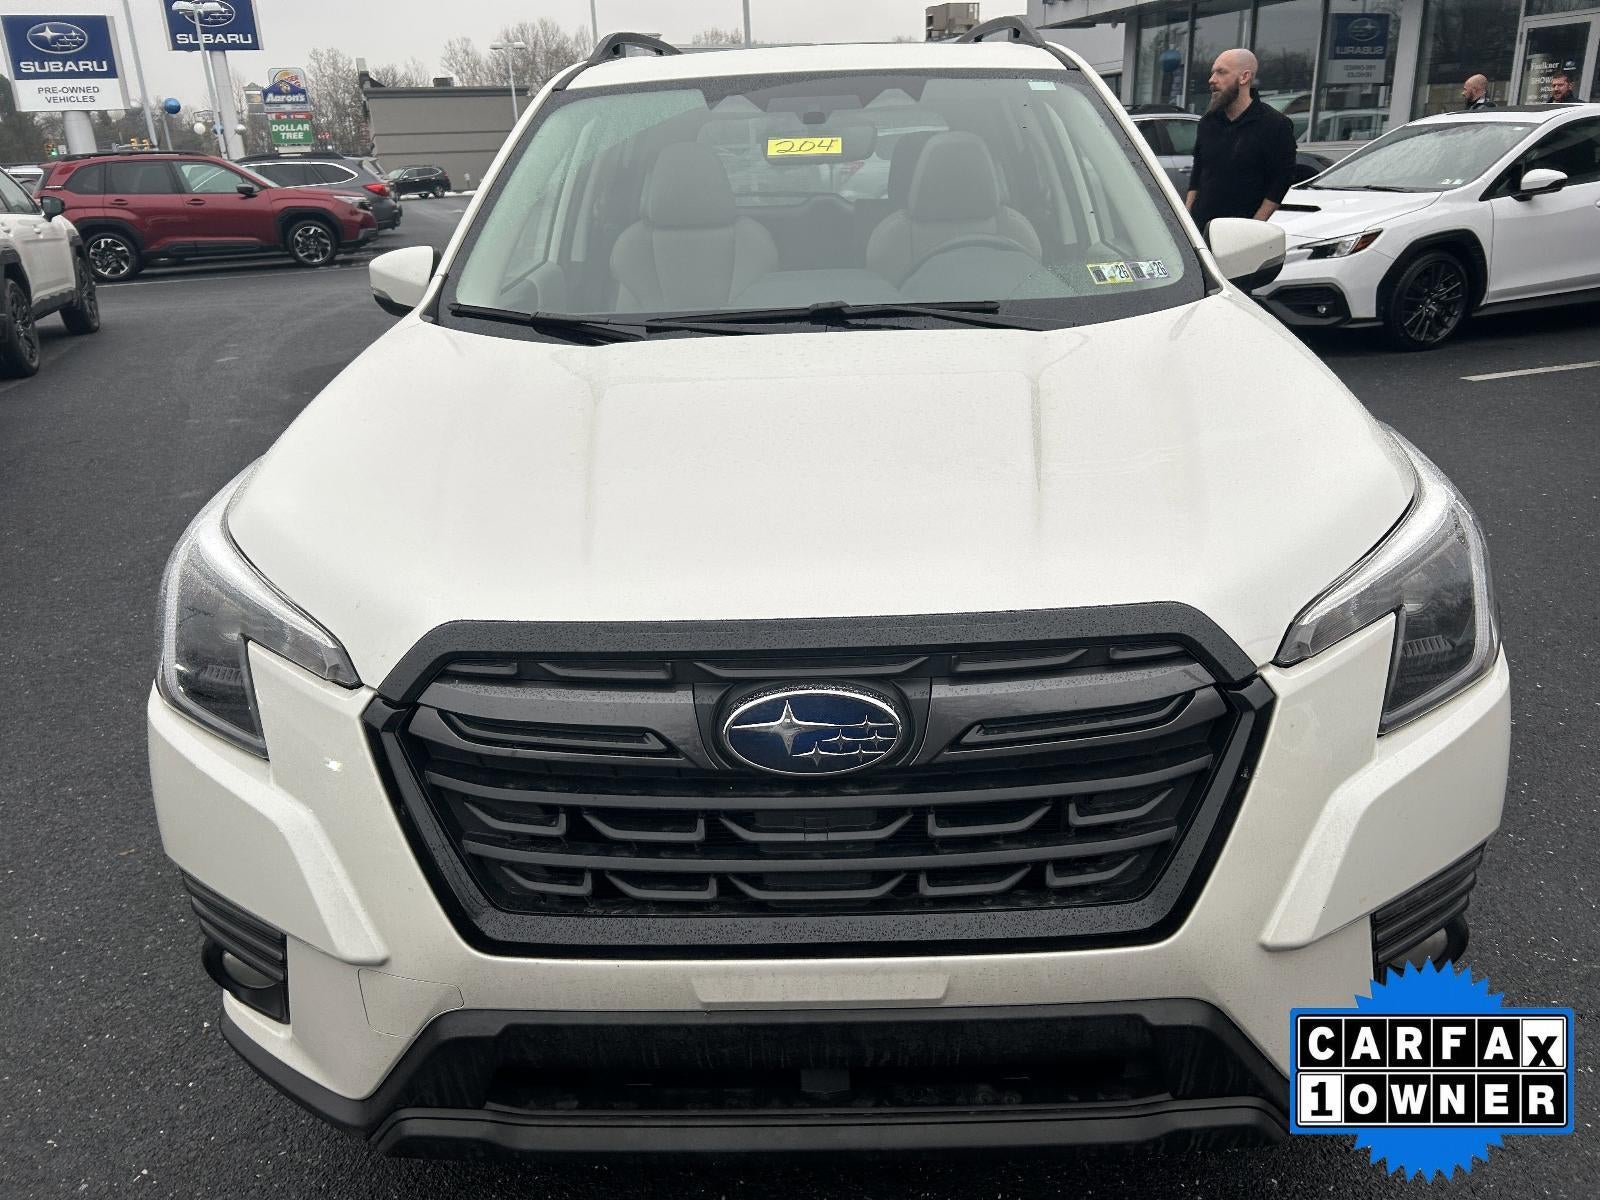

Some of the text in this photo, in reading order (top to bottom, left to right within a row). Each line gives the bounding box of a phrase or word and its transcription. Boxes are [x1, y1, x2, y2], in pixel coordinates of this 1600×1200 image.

[176, 33, 252, 44] SUBARU
[20, 61, 108, 73] SUBARU
[37, 86, 100, 95] PRE-OWNED
[45, 95, 96, 104] VEHICLES
[272, 123, 310, 132] DOLLAR
[280, 131, 304, 140] TREE
[775, 139, 838, 154] 204
